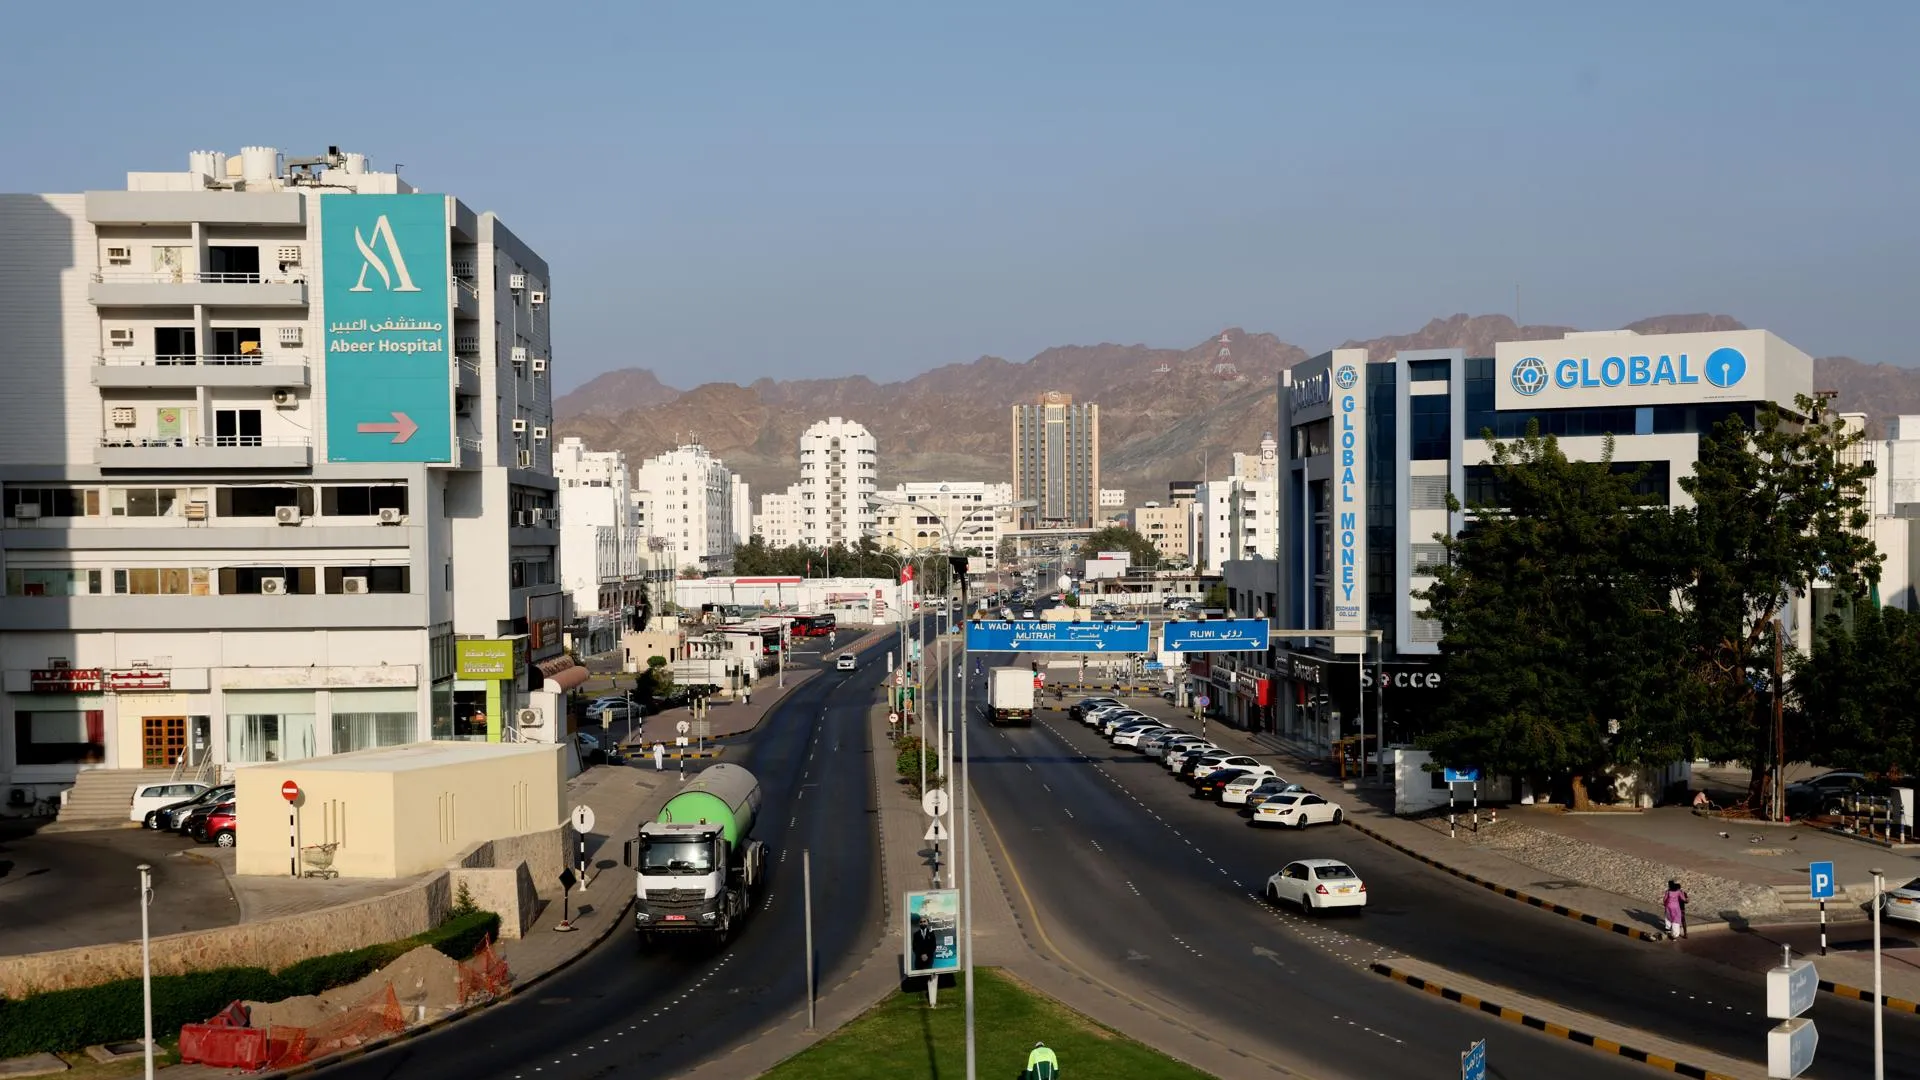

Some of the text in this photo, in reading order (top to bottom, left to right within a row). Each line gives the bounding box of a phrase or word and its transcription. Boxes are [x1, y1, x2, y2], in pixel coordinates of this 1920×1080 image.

[329, 316, 442, 333] مستشفى العبير
[330, 338, 443, 355] Abeer Hospital
[1555, 354, 1699, 389] GLOBAL
[1341, 395, 1355, 502] GLOBAL
[1340, 512, 1355, 601] MONEY
[974, 623, 1056, 631] AL WADI AL KABIR
[1103, 624, 1141, 633] الوادي
[1190, 630, 1215, 638] RUWI
[1220, 629, 1243, 640] روي
[1016, 632, 1056, 640] MUTRAH
[1816, 874, 1828, 893] P
